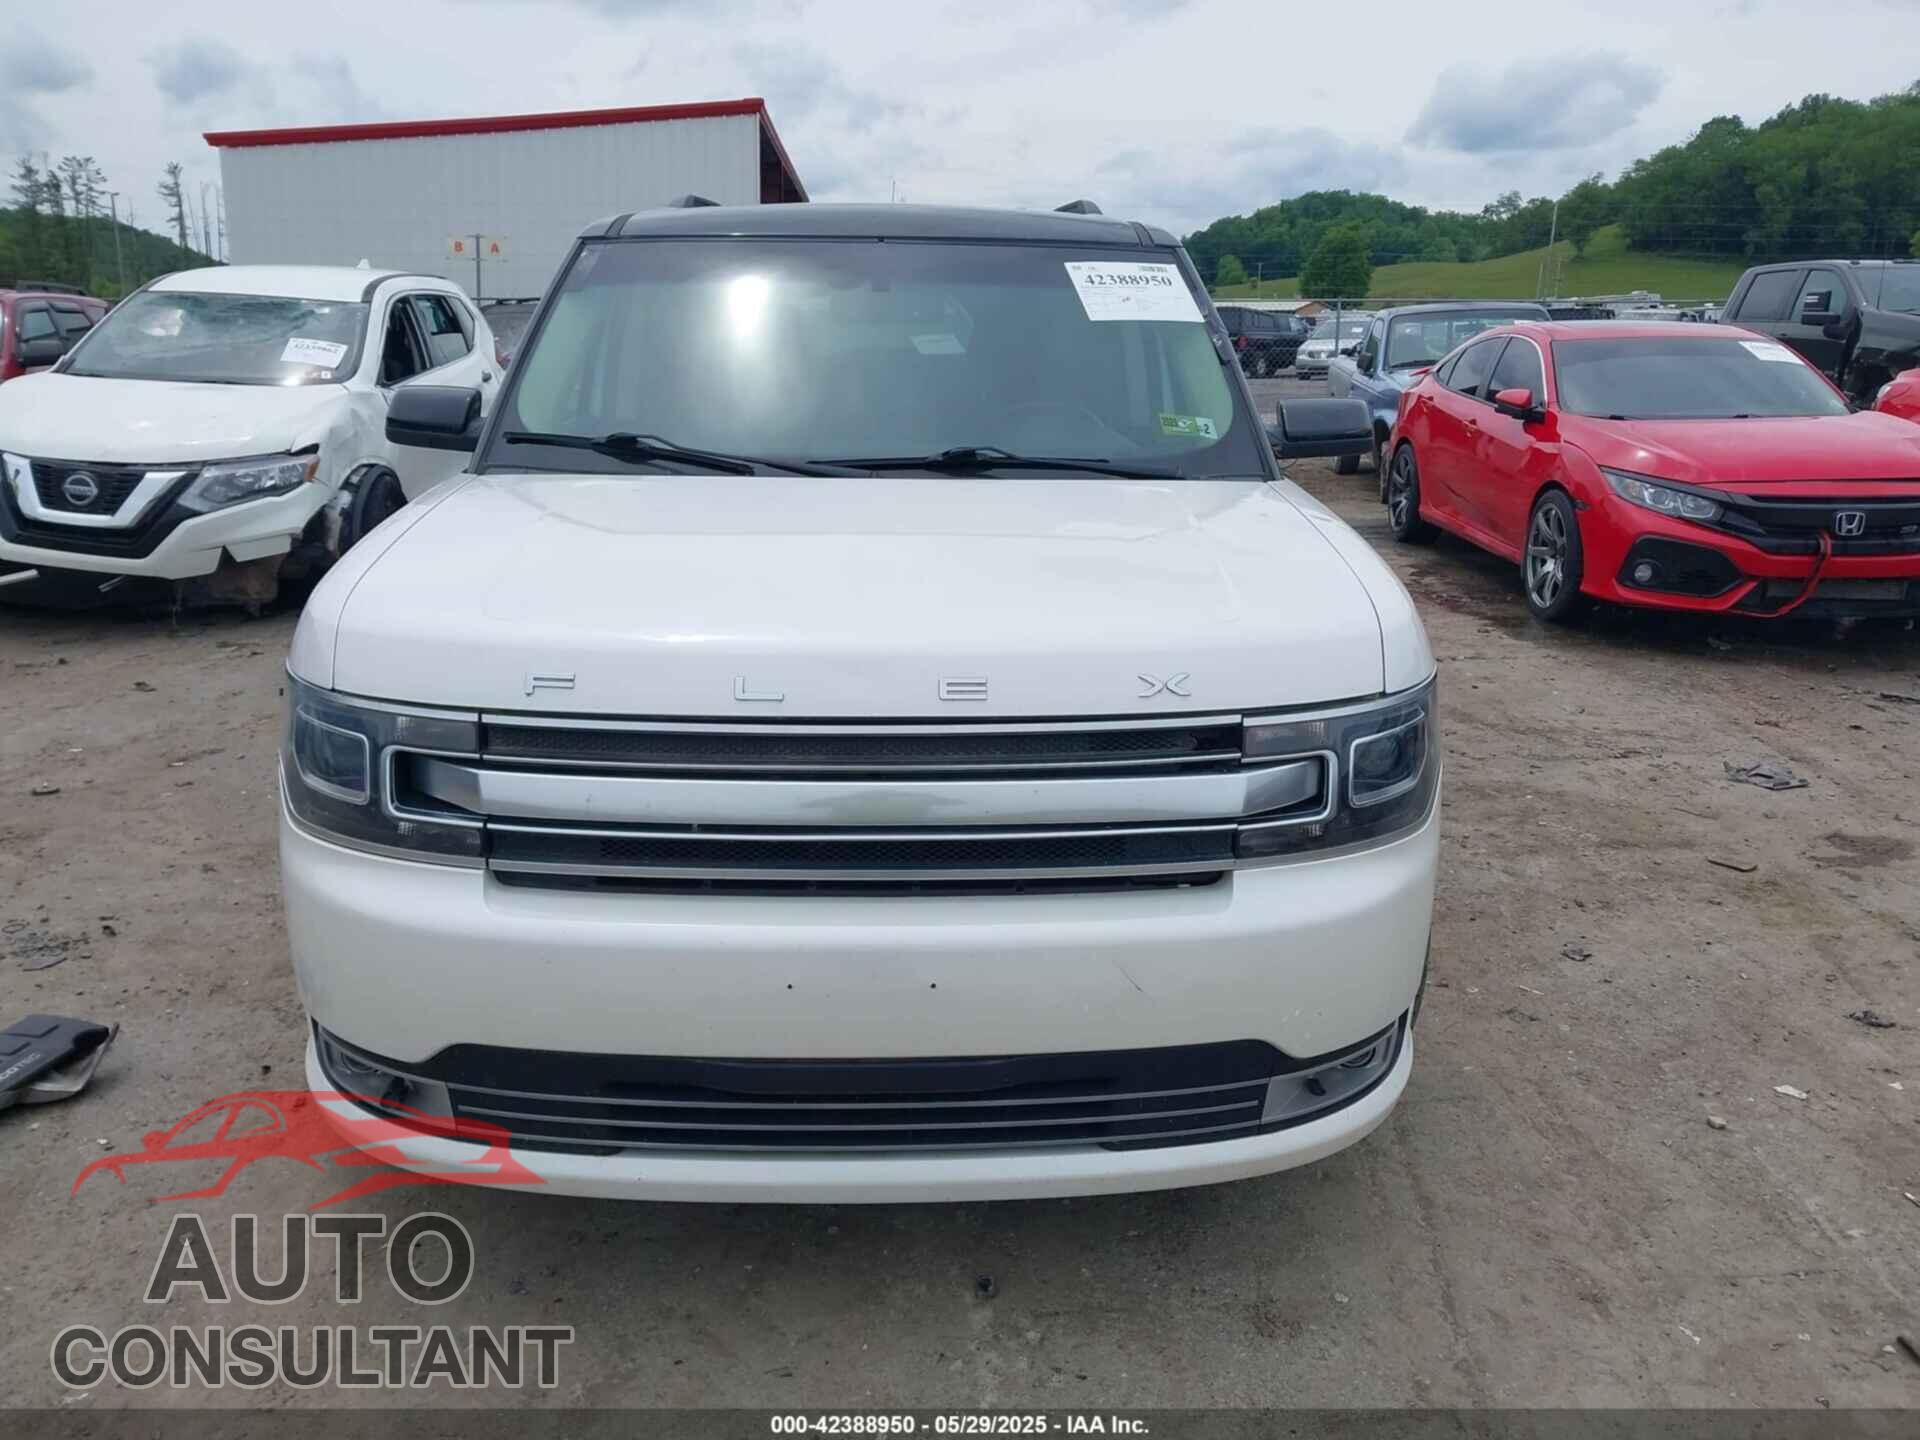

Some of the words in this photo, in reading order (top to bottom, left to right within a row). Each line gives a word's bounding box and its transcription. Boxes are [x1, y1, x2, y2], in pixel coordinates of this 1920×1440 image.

[490, 241, 500, 254] A
[1084, 273, 1173, 287] 42388950
[525, 672, 1191, 702] FLEX
